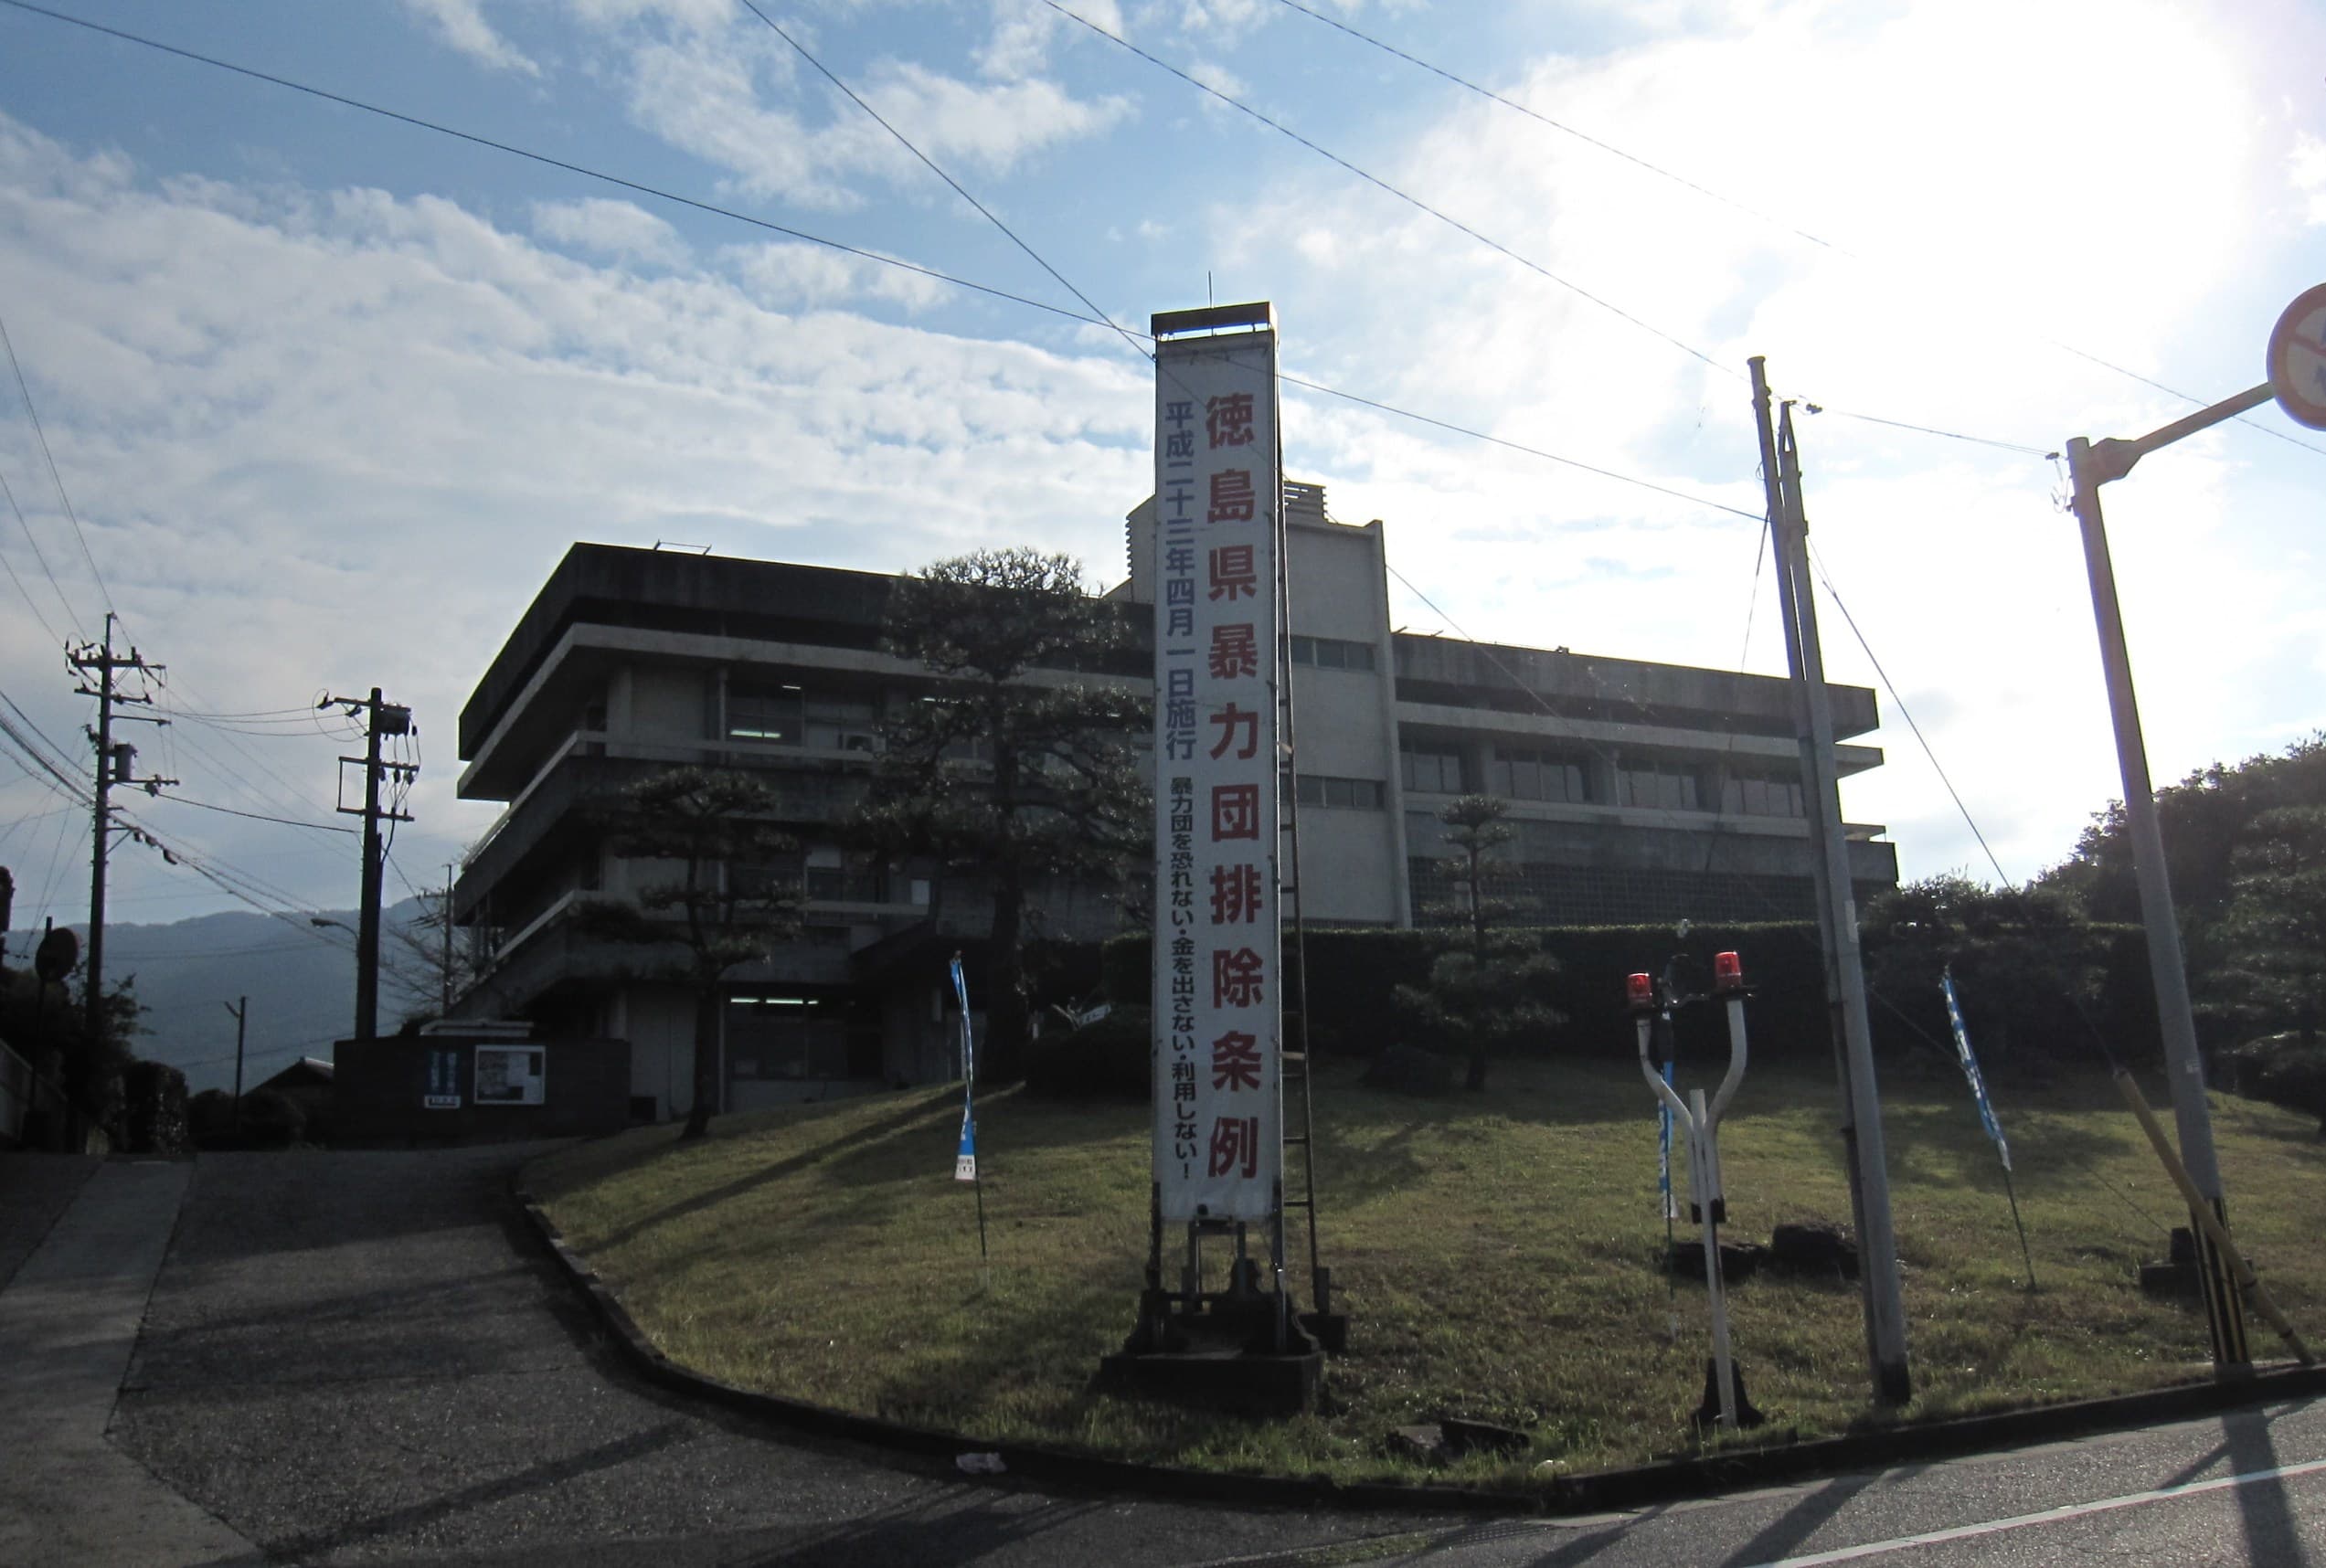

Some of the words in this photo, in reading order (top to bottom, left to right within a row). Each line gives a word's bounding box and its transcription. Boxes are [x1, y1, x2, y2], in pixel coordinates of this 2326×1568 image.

[1165, 402, 1195, 760] 平成二十三年四月一日施行
[1205, 393, 1263, 1178] 徳島県暴力団排除条例
